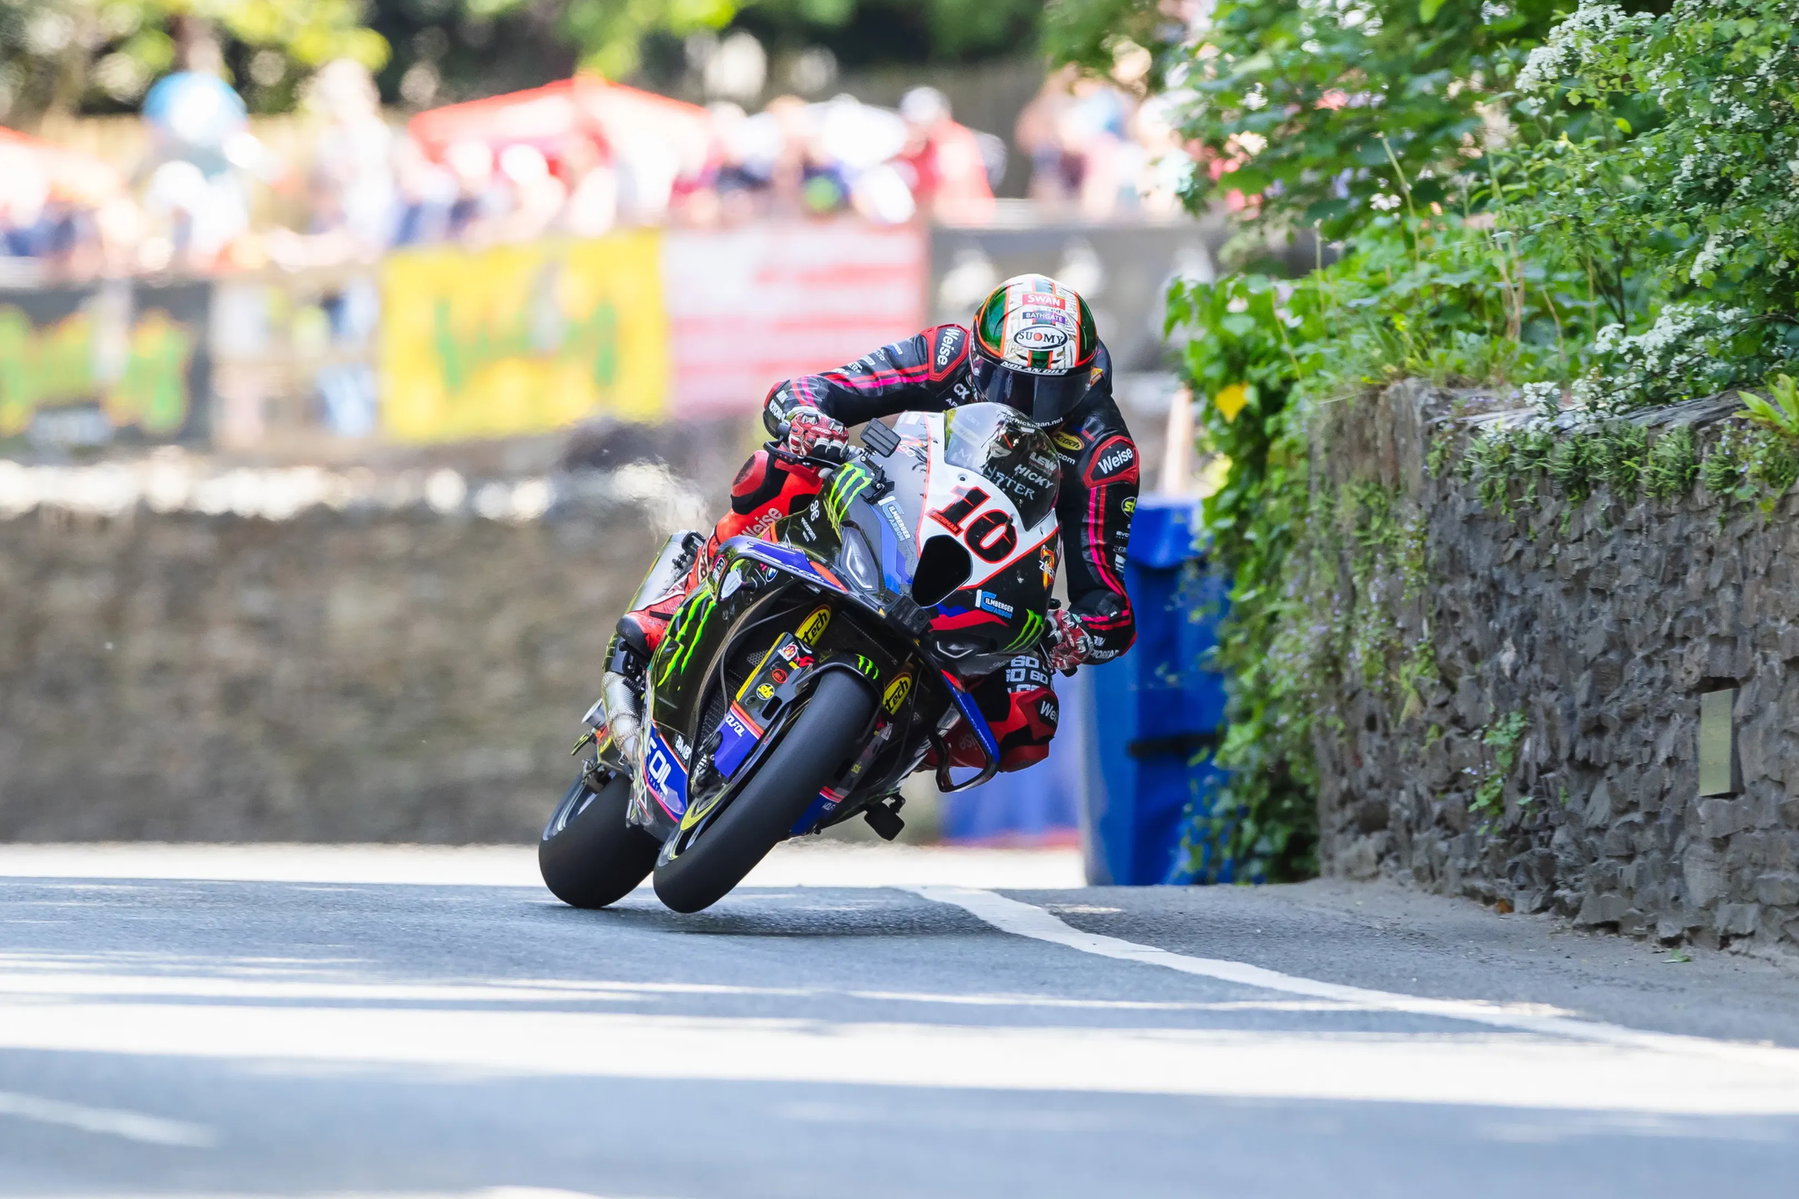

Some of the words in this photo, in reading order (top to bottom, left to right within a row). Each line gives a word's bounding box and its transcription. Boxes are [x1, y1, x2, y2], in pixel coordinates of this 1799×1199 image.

[1027, 294, 1061, 307] SWAN
[1025, 311, 1064, 323] BATHGATE
[936, 328, 961, 366] Weise
[1018, 329, 1064, 345] SUOMY
[1097, 447, 1134, 475] Weise
[1013, 463, 1054, 489] HICKY
[925, 485, 1018, 565] 10
[985, 597, 1014, 614] ILMBERGER
[724, 714, 746, 738] OLFOIL
